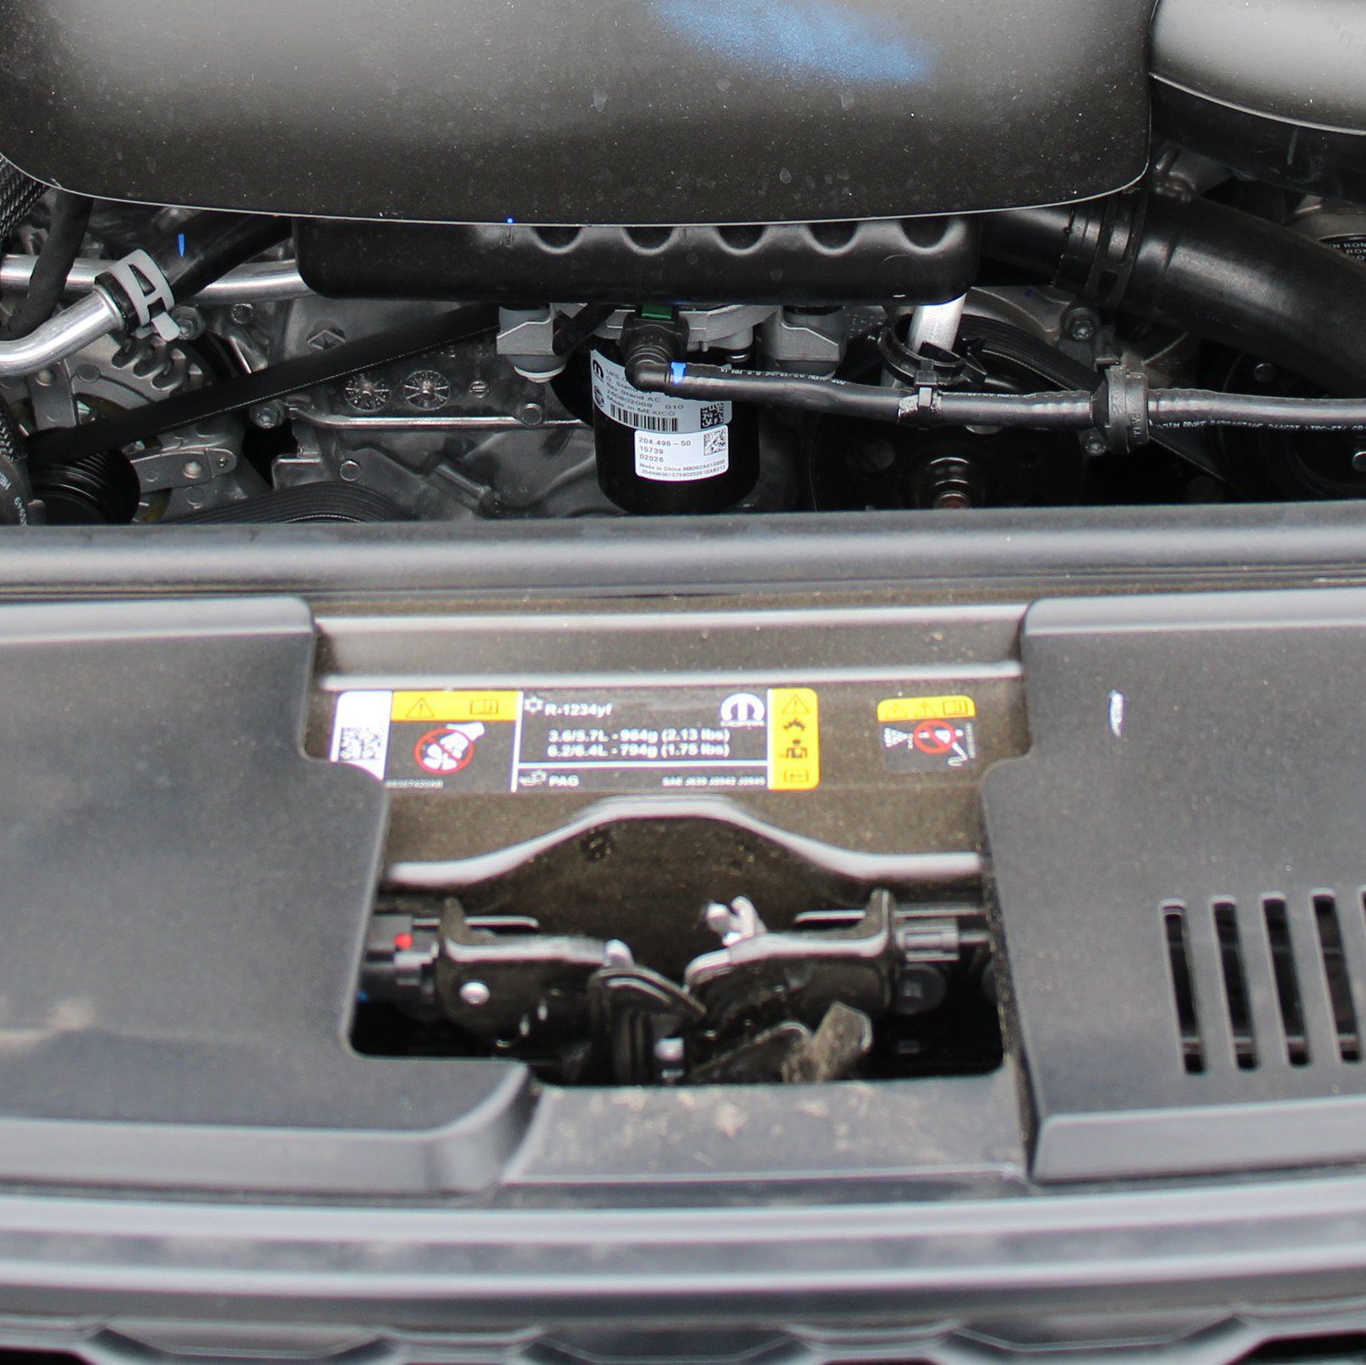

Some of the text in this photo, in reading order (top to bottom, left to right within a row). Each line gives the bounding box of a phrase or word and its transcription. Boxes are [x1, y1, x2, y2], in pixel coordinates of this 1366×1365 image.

[606, 395, 624, 408] Made
[637, 407, 675, 416] MEXICO
[639, 445, 664, 455] 15739
[639, 453, 664, 463] 02026
[544, 702, 613, 718] R-1234yf
[548, 729, 608, 743] 3.6/5.7L
[701, 729, 730, 743] lbs)
[620, 744, 658, 759] 794g
[701, 743, 730, 757] lbs)
[549, 775, 580, 787] PAG
